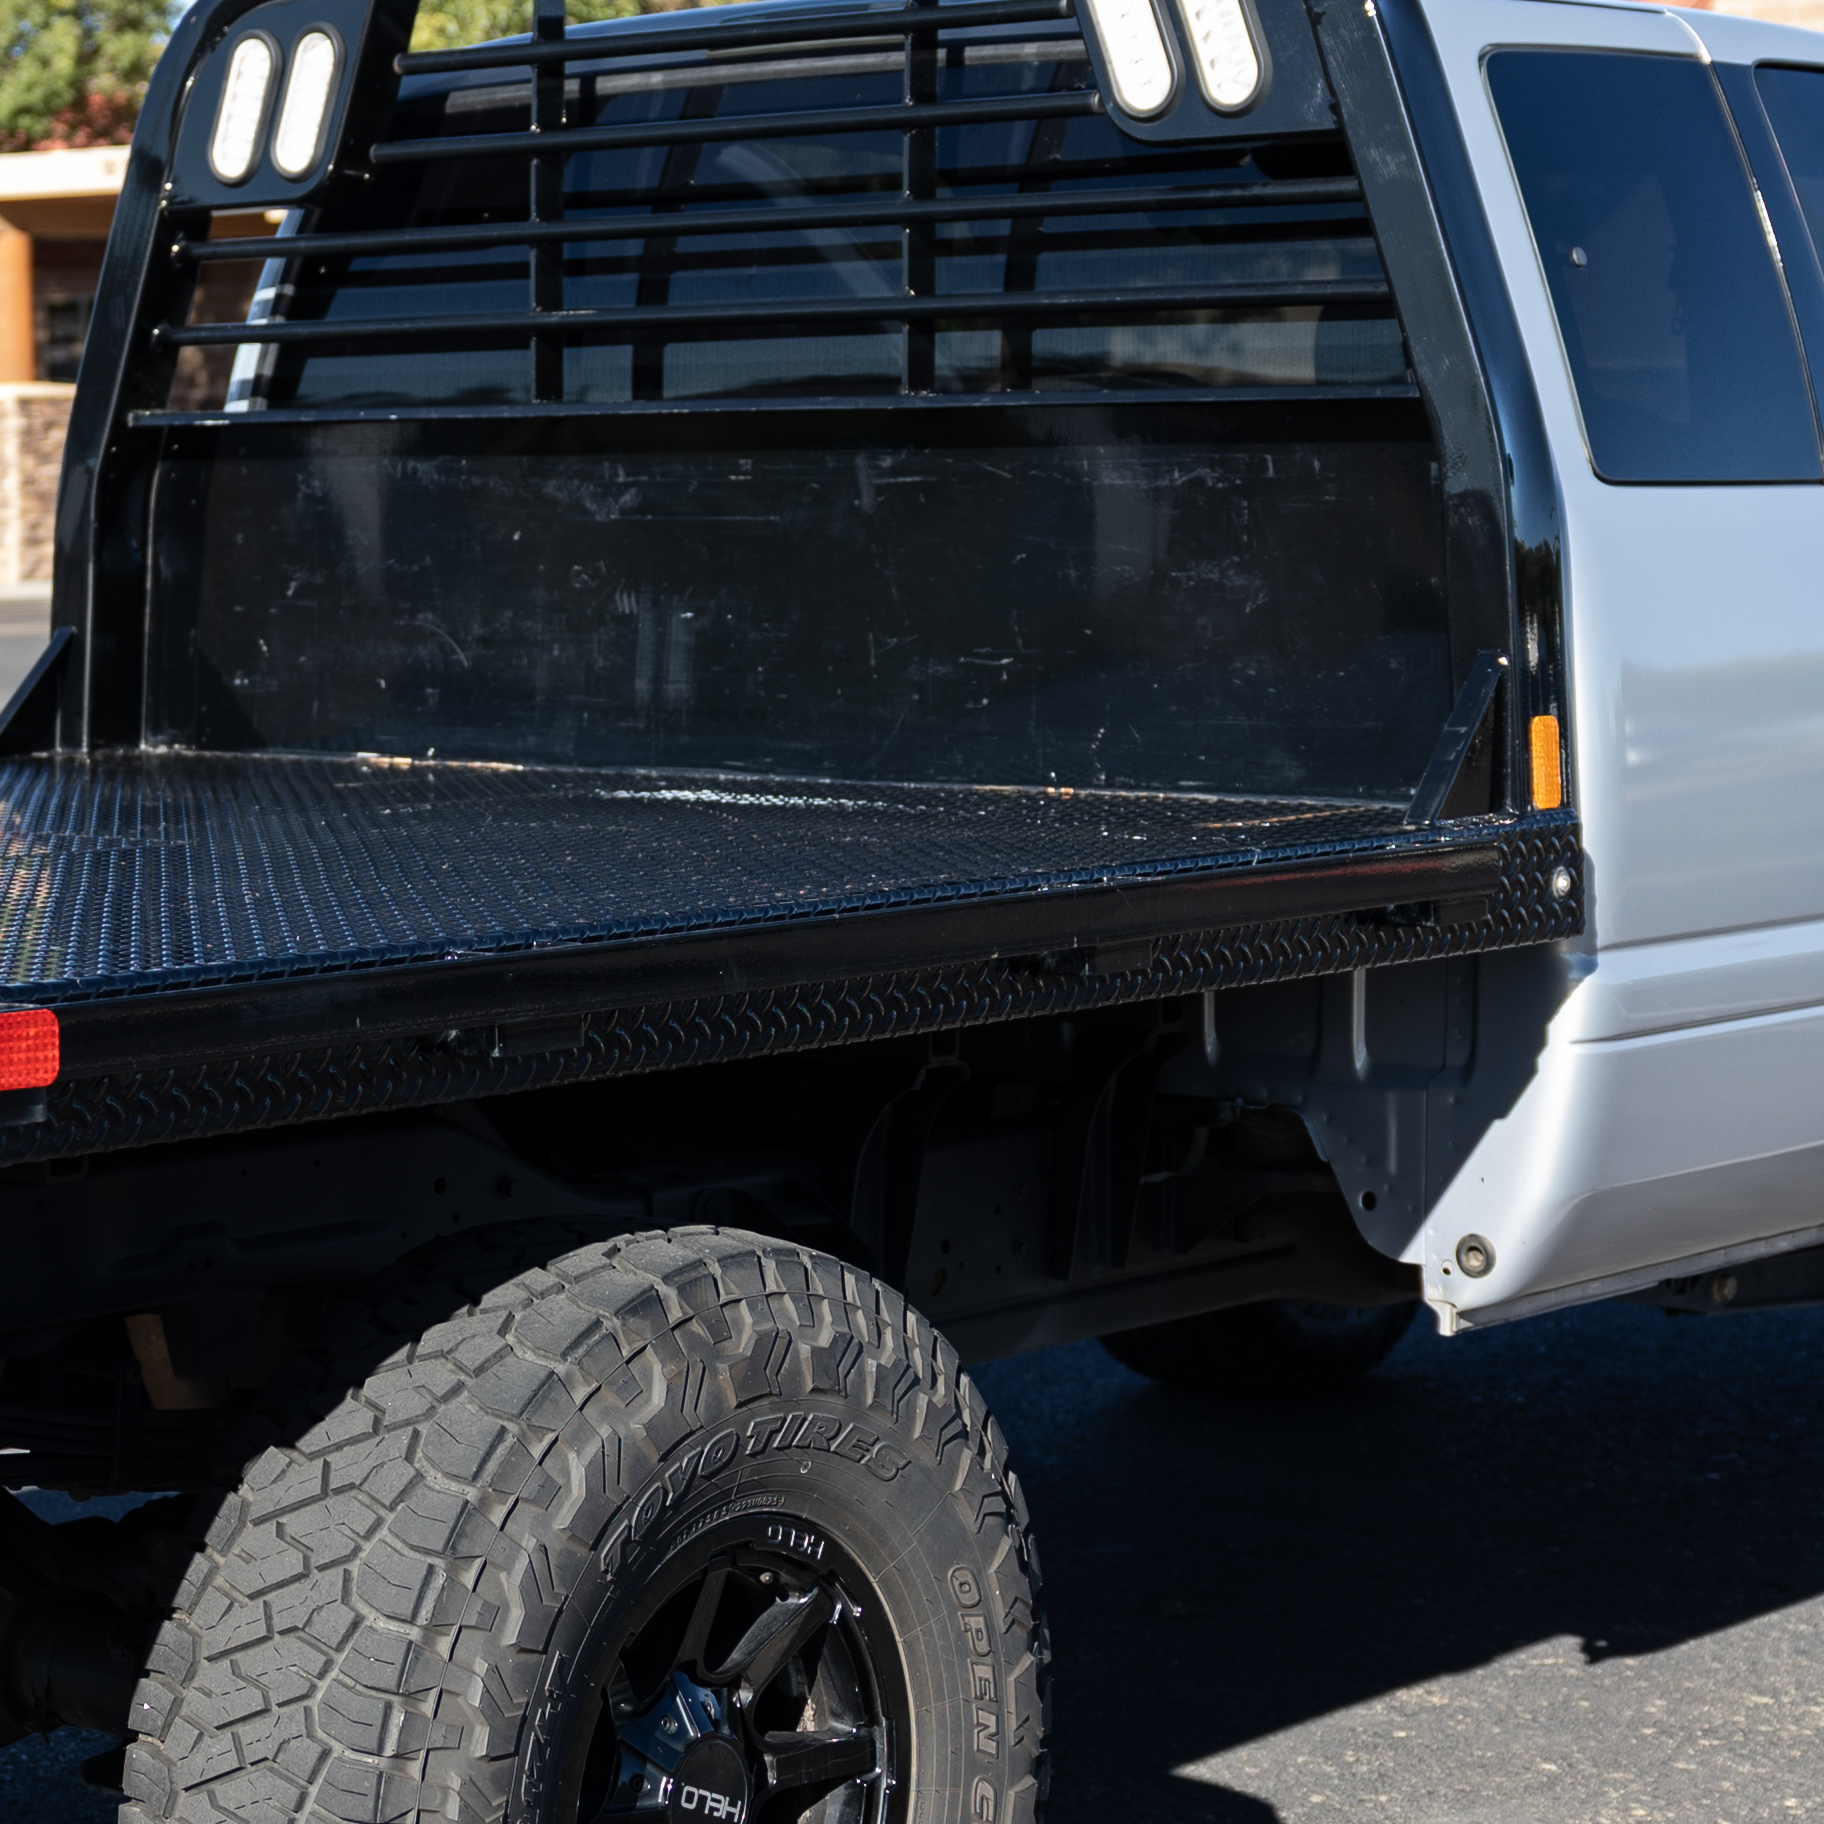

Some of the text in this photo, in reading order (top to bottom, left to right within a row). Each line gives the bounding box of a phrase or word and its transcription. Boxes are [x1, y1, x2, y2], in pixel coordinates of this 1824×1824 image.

[600, 1428, 740, 1576] TOYO
[745, 1412, 912, 1482] TIRES
[767, 1524, 825, 1560] HELO
[948, 1565, 1000, 1760] OPEN
[680, 1785, 742, 1823] HELO
